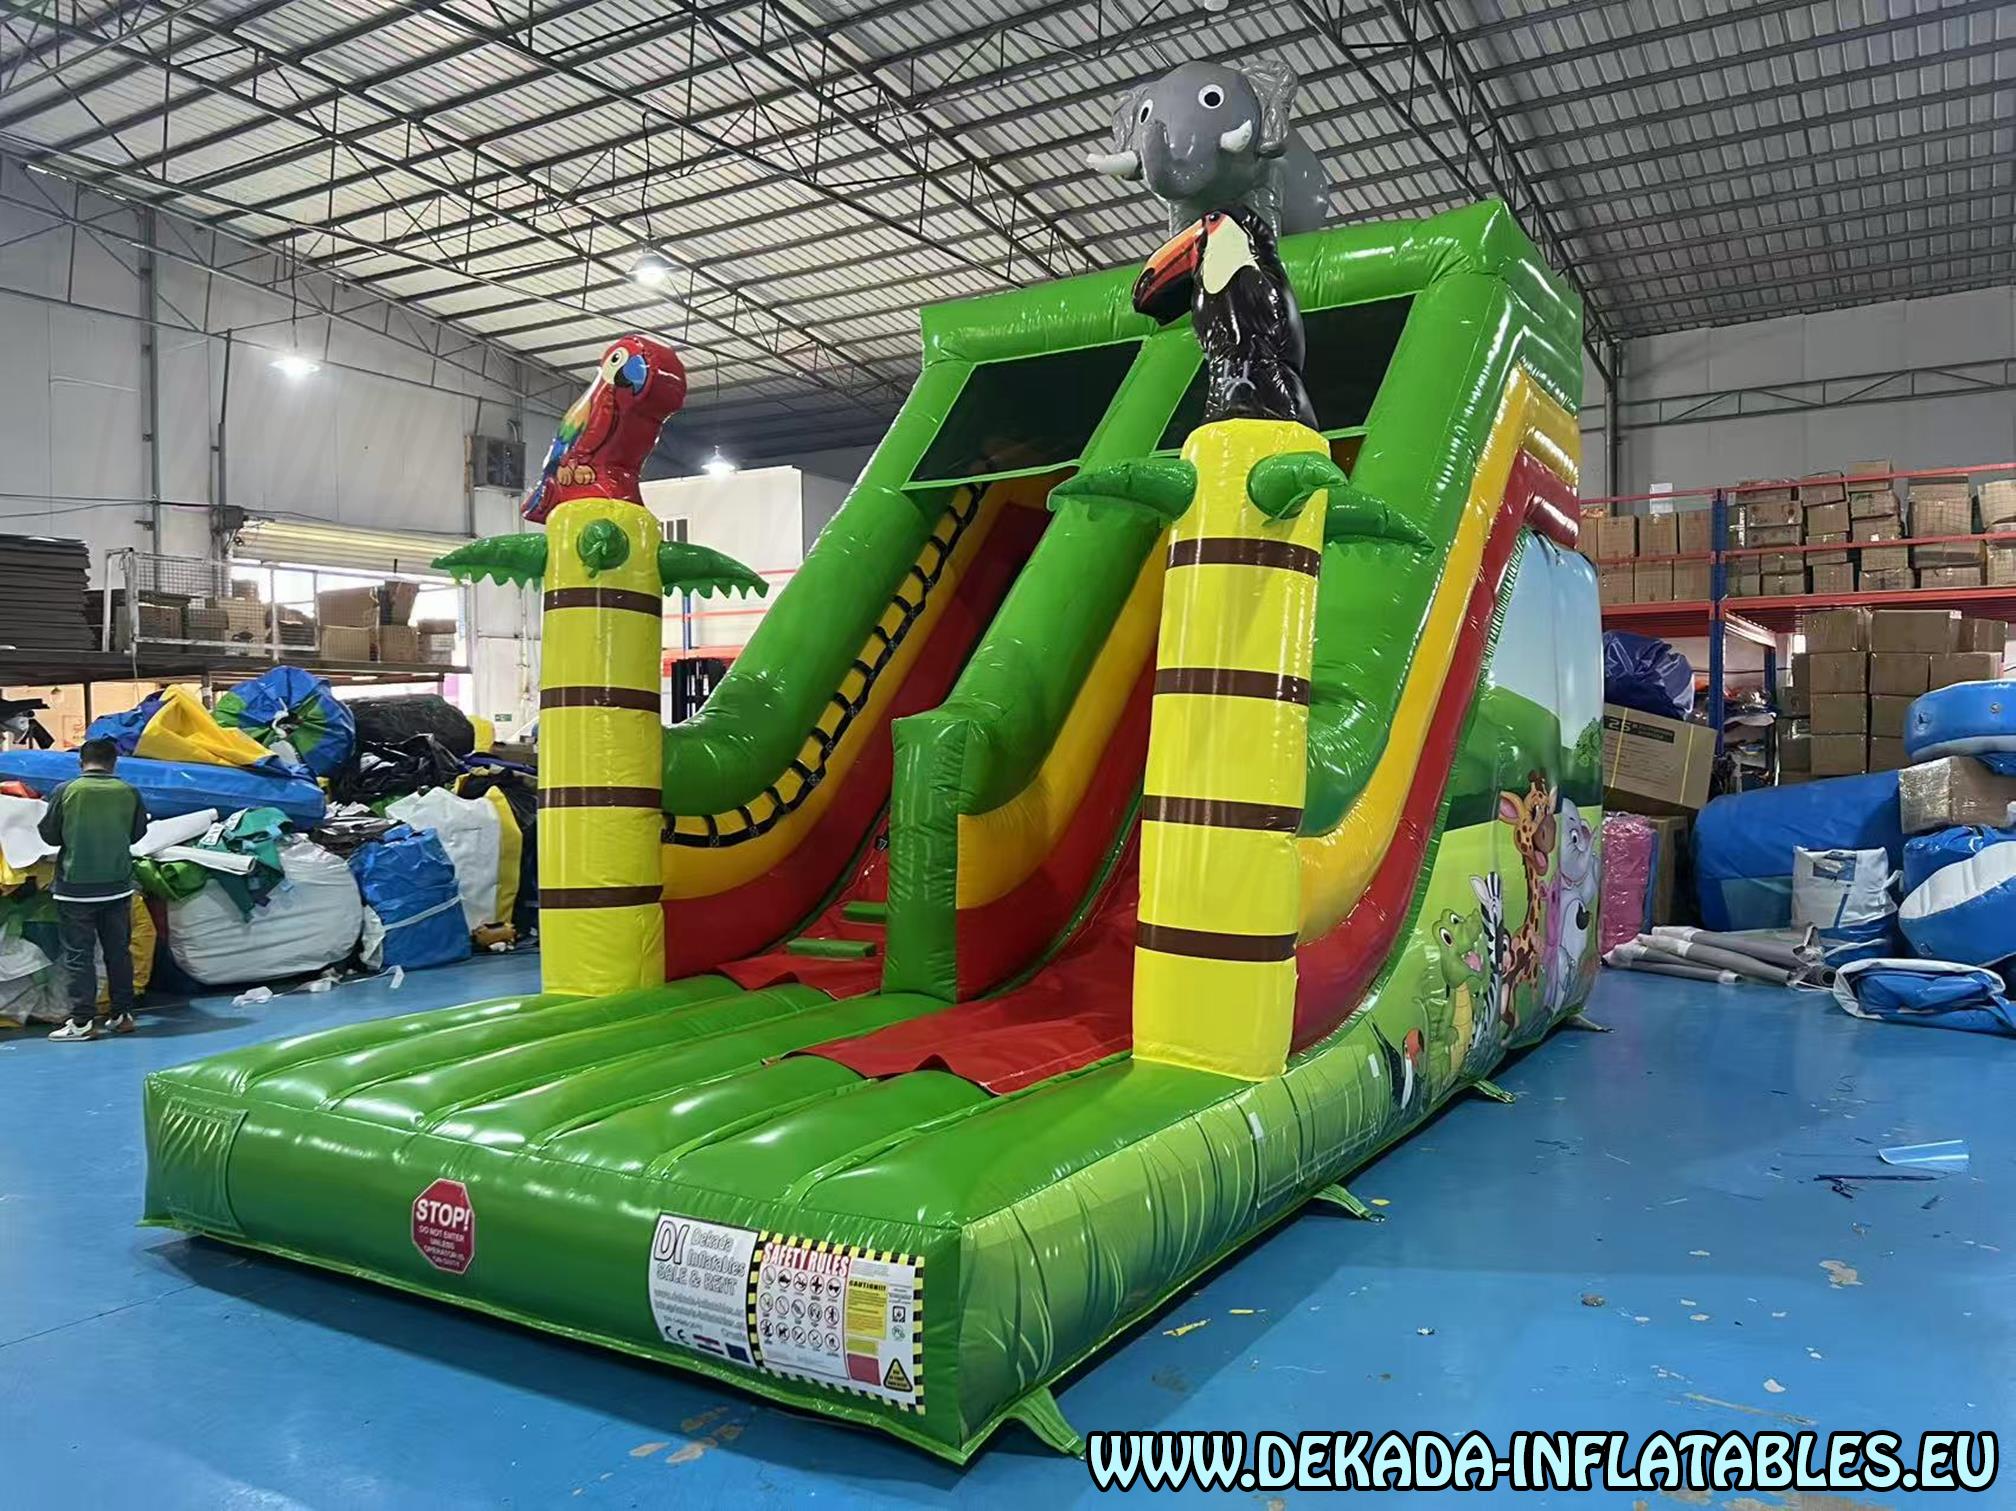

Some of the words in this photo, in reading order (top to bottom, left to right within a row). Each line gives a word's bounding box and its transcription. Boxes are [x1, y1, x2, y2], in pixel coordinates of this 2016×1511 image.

[415, 1198, 471, 1231] STOP!
[429, 1228, 442, 1237] NOT
[654, 1220, 690, 1265] DI
[690, 1227, 734, 1251] Dekada
[687, 1249, 746, 1277] Inflatables
[763, 1242, 809, 1270] SAFETY
[807, 1250, 849, 1277] RULES
[657, 1262, 688, 1285] SALE
[689, 1270, 702, 1288] &
[703, 1273, 738, 1295] RENT
